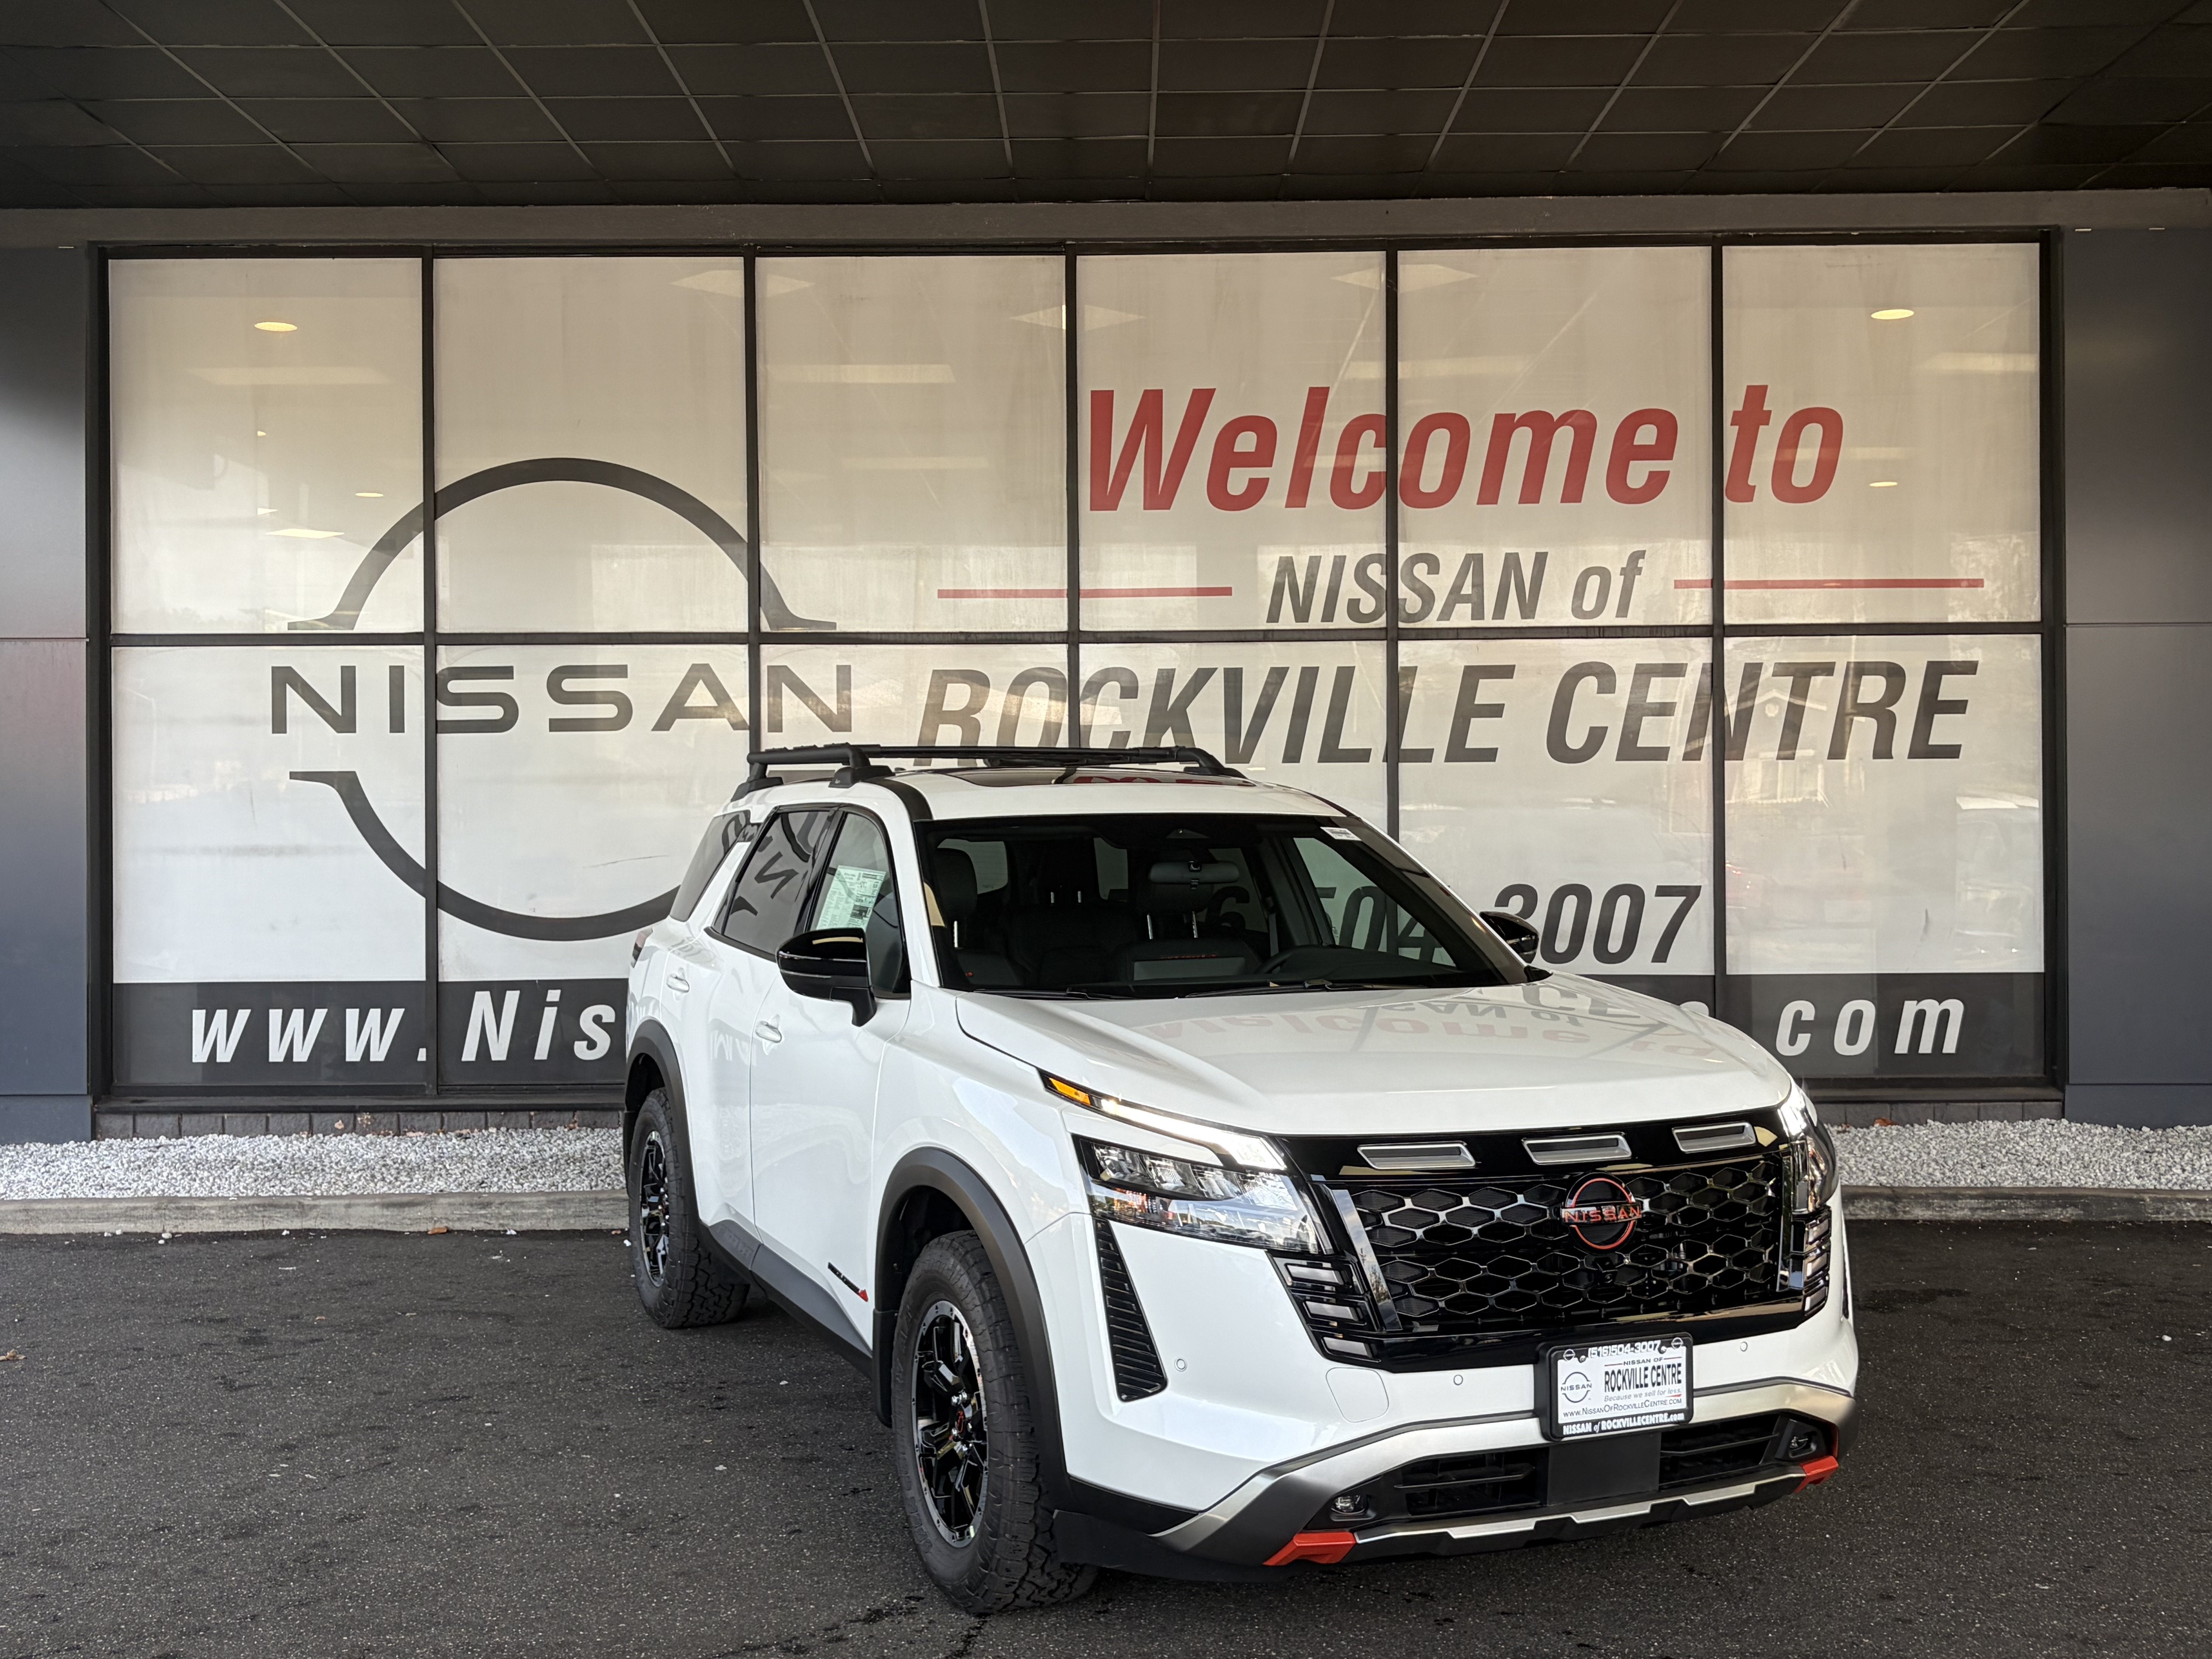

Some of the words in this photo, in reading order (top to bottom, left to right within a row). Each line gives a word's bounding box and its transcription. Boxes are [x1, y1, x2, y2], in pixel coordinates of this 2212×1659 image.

[1090, 386, 1678, 511] Welcome
[1724, 385, 1844, 504] to
[1266, 551, 1547, 623] NISSAN
[1571, 550, 1646, 620] of
[271, 663, 852, 735] NISSAN
[912, 665, 1516, 766] ROCKVILLE
[1546, 660, 1979, 764] CENTRE
[1565, 1206, 1641, 1223] NISSAN
[1589, 1340, 1661, 1358] (516)504-3007
[1561, 1383, 1592, 1391] NISSAN
[1604, 1367, 1649, 1393] ROCKVILLE
[1650, 1363, 1682, 1388] CENTRE
[1563, 1422, 1592, 1435] NISSAN
[1593, 1421, 1601, 1433] of
[1601, 1412, 1685, 1431] ROCKVILLECENTRE.com
